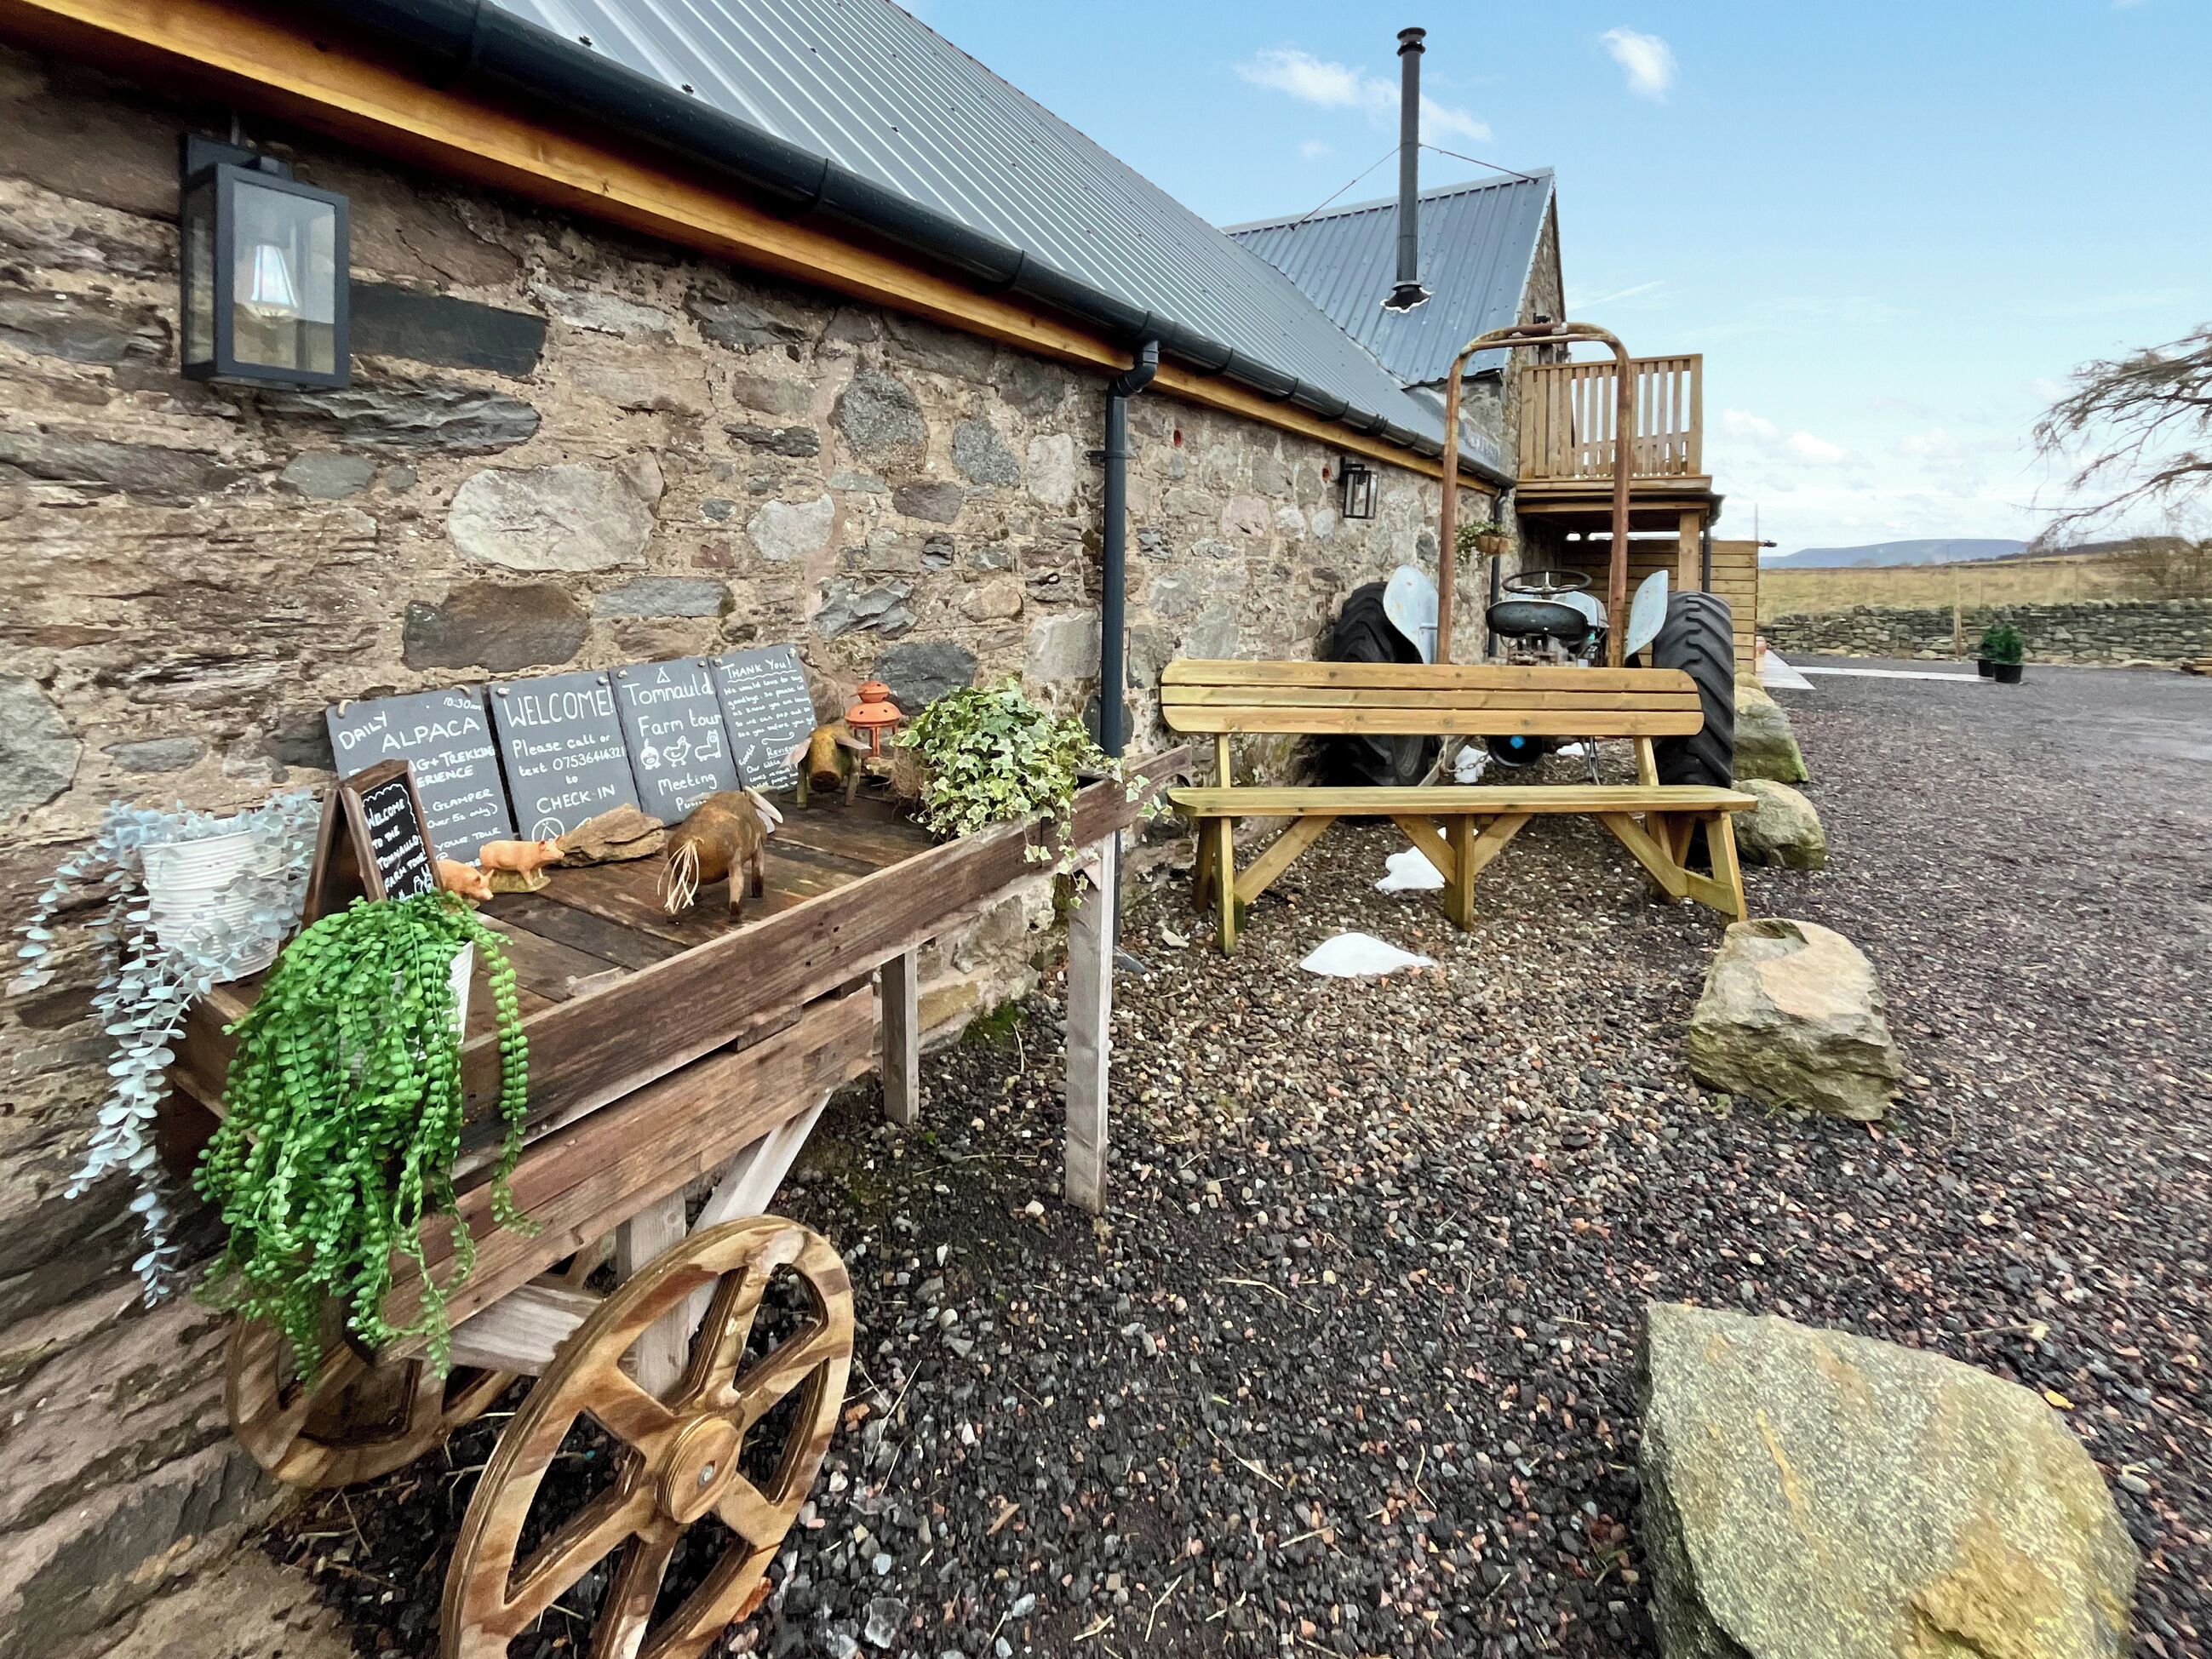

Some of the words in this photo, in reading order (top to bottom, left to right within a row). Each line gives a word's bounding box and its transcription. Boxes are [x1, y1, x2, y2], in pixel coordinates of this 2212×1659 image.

[622, 672, 713, 707] Tomnauld
[503, 684, 614, 728] WELCOME!
[338, 711, 387, 750] DAILY
[382, 717, 480, 752] ALPACA
[638, 715, 684, 737] Farm
[688, 708, 722, 728] tour
[512, 738, 562, 758] Please
[566, 734, 595, 750] call
[599, 735, 610, 743] or
[415, 764, 474, 788] ERIENCE
[519, 762, 547, 777] text
[565, 775, 578, 785] to
[657, 773, 718, 796] Meeting
[433, 788, 494, 811] GLAMPER
[364, 798, 405, 830] WELCOME
[371, 838, 383, 850] TO
[384, 825, 400, 842] THE
[376, 834, 420, 871] TOMNAULD
[384, 867, 407, 893] FARM
